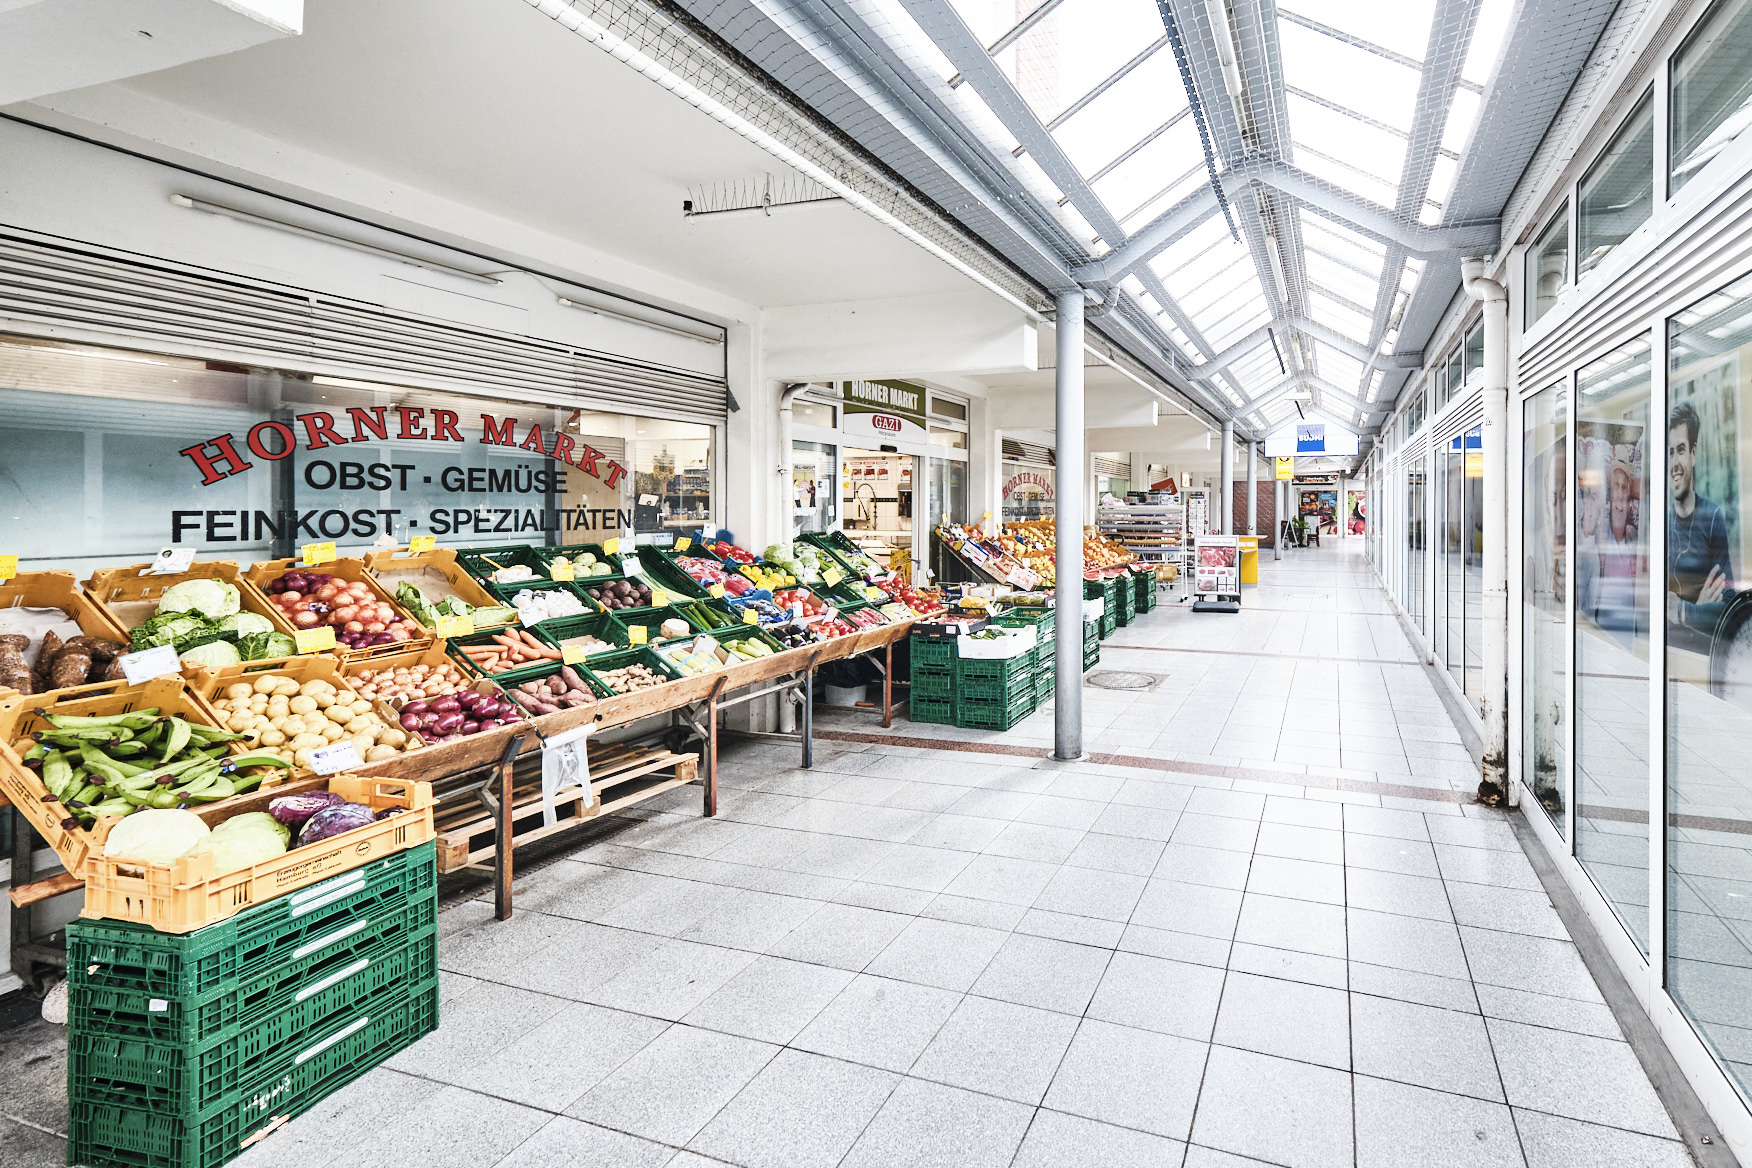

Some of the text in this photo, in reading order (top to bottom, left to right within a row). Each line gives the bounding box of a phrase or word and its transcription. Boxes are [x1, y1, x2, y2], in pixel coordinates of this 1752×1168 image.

[852, 380, 919, 411] HORNER MARKT
[179, 406, 628, 490] HORNER MARKT
[304, 460, 568, 494] OBST GEMÜSE
[1002, 472, 1031, 501] HORNER
[172, 504, 632, 543] FEINKOST SPEZIALITÄTEN
